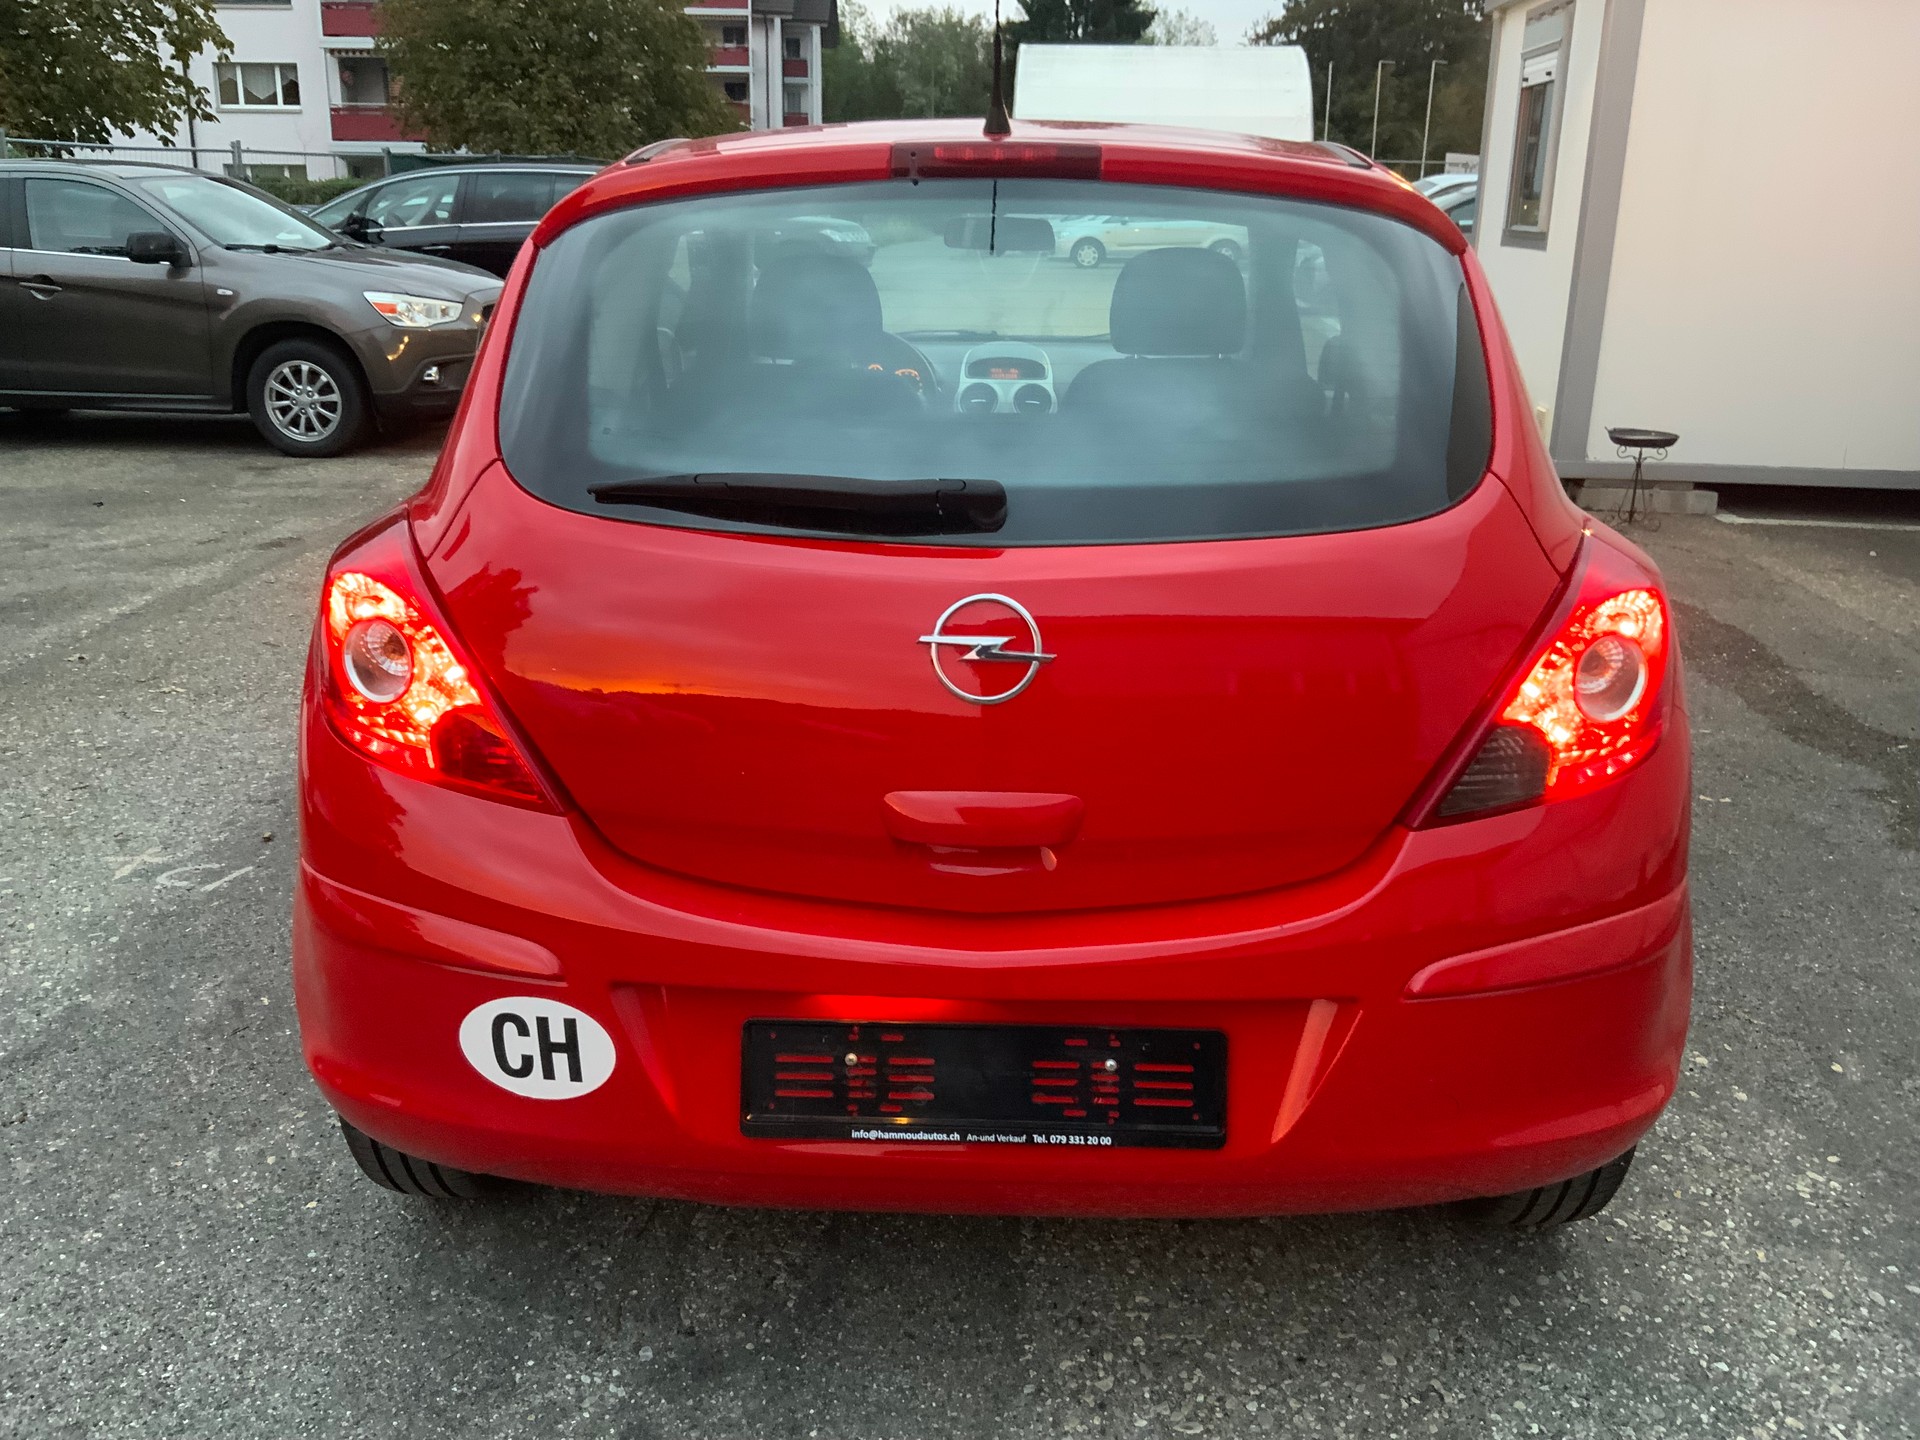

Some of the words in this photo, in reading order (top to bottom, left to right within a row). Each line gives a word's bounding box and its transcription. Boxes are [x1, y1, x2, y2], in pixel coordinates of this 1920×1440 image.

[491, 1012, 583, 1082] CH
[851, 1129, 960, 1141] info@hammoudautos.ch
[996, 1134, 1027, 1143] Verkauf
[1032, 1134, 1048, 1144] Tel.
[1050, 1135, 1067, 1144] 079
[1069, 1135, 1085, 1145] 331
[1087, 1136, 1099, 1145] 20
[1099, 1136, 1112, 1146] 00
